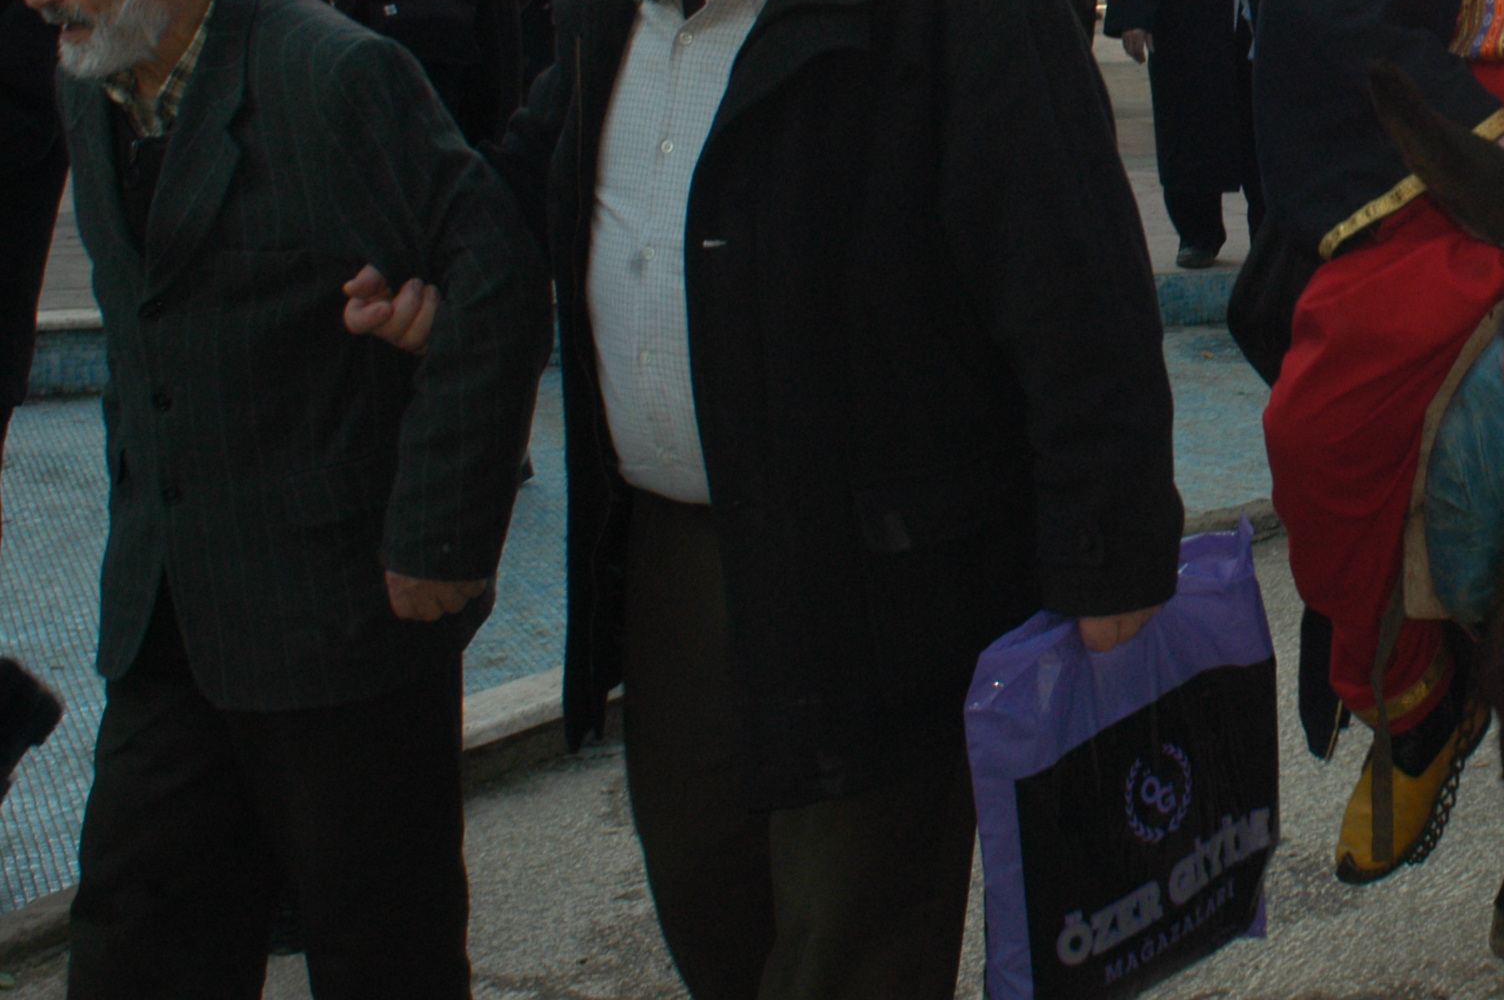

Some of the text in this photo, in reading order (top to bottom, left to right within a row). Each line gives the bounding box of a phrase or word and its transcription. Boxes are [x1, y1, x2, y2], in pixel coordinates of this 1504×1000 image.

[1056, 806, 1272, 967] ÖZER GİYİM
[1104, 879, 1236, 984] MAĞAZALARI
